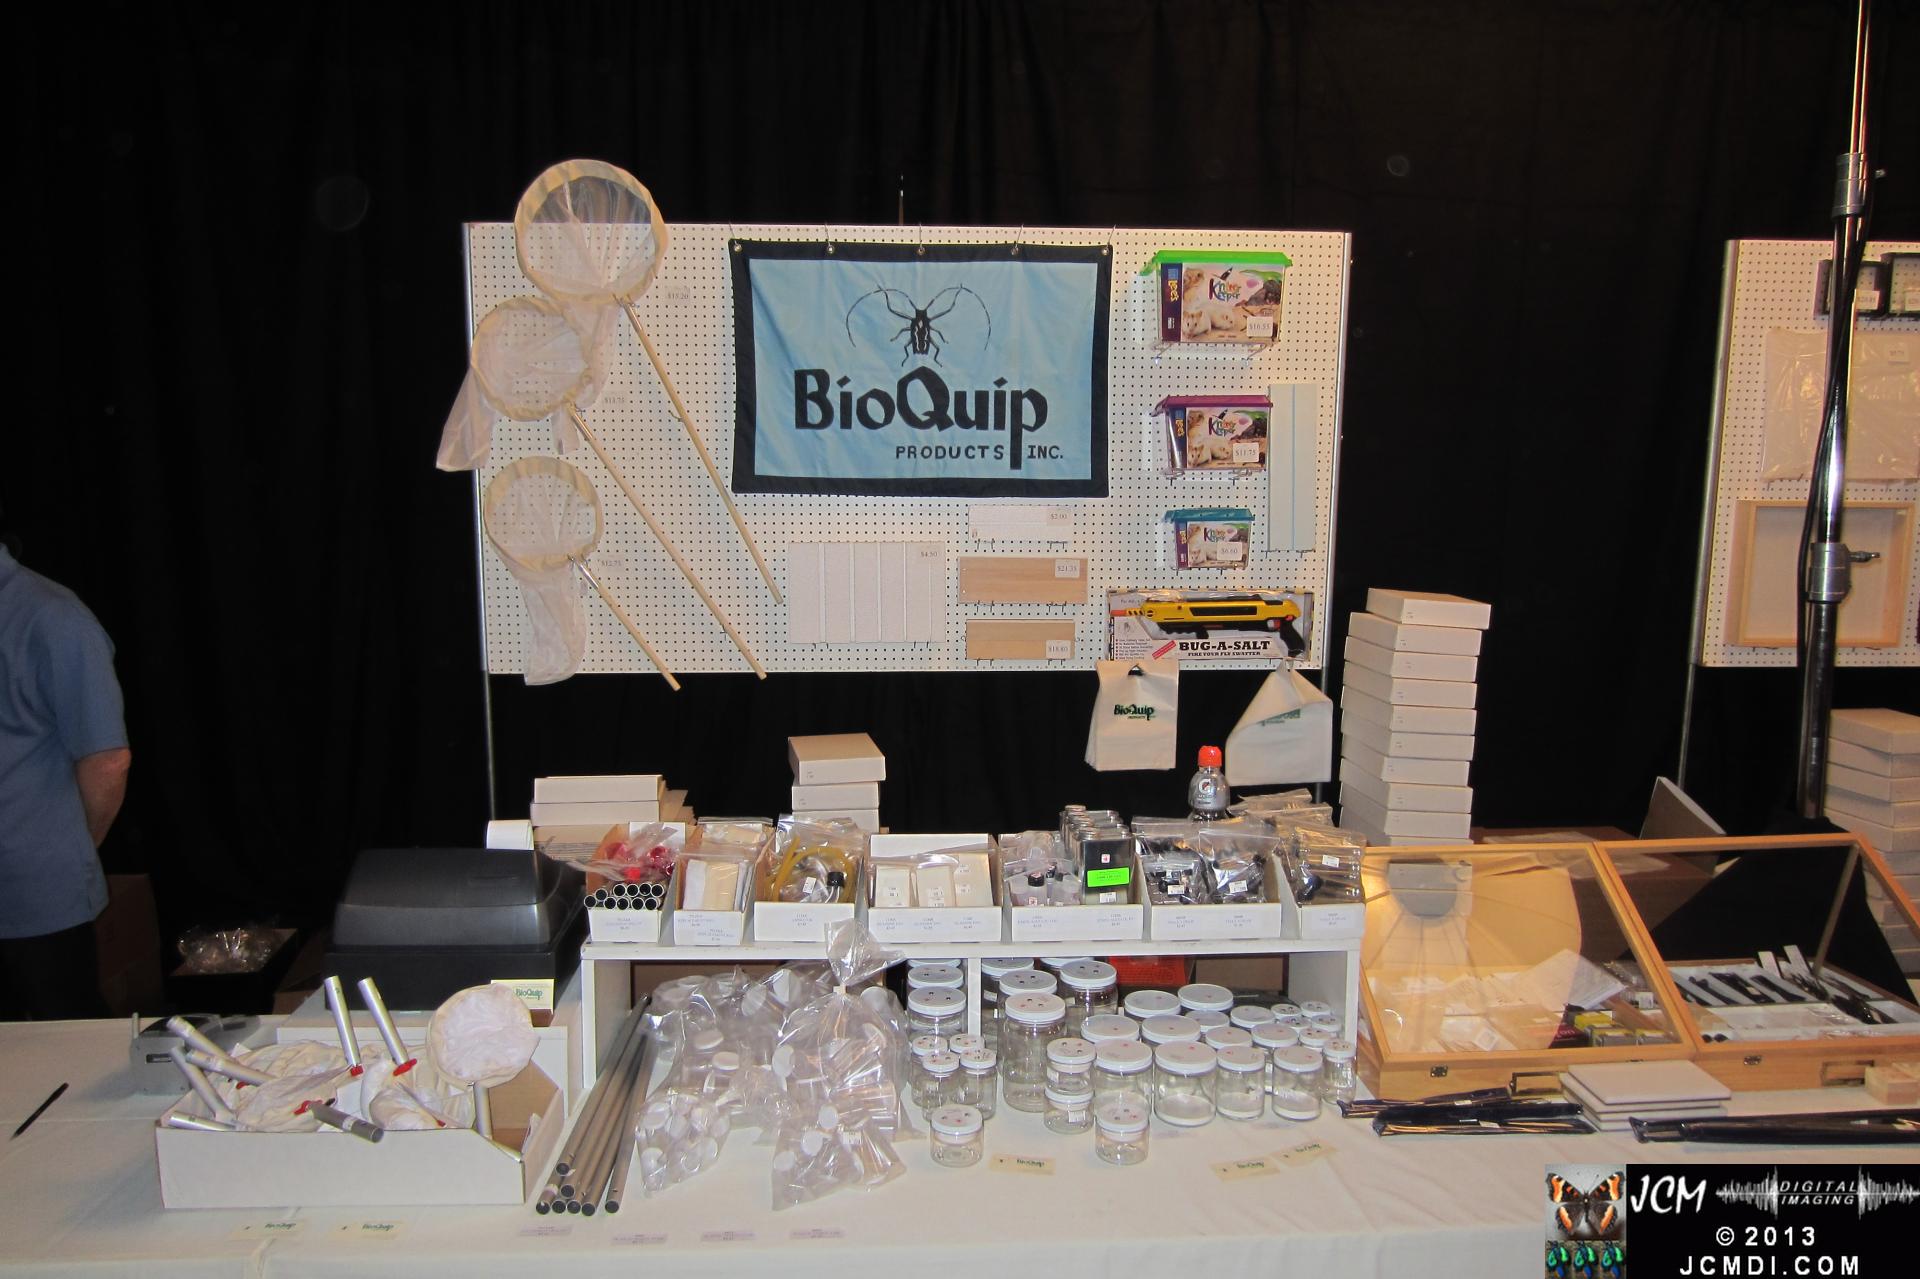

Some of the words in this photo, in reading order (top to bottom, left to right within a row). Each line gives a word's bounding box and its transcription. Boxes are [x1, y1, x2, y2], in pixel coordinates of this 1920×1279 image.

[794, 365, 1049, 470] BioQuip
[895, 444, 1004, 461] PRODUCTS
[1027, 444, 1065, 460] INC.
[1178, 640, 1271, 651] BUG-A-SALT
[1113, 703, 1155, 721] BioQuip
